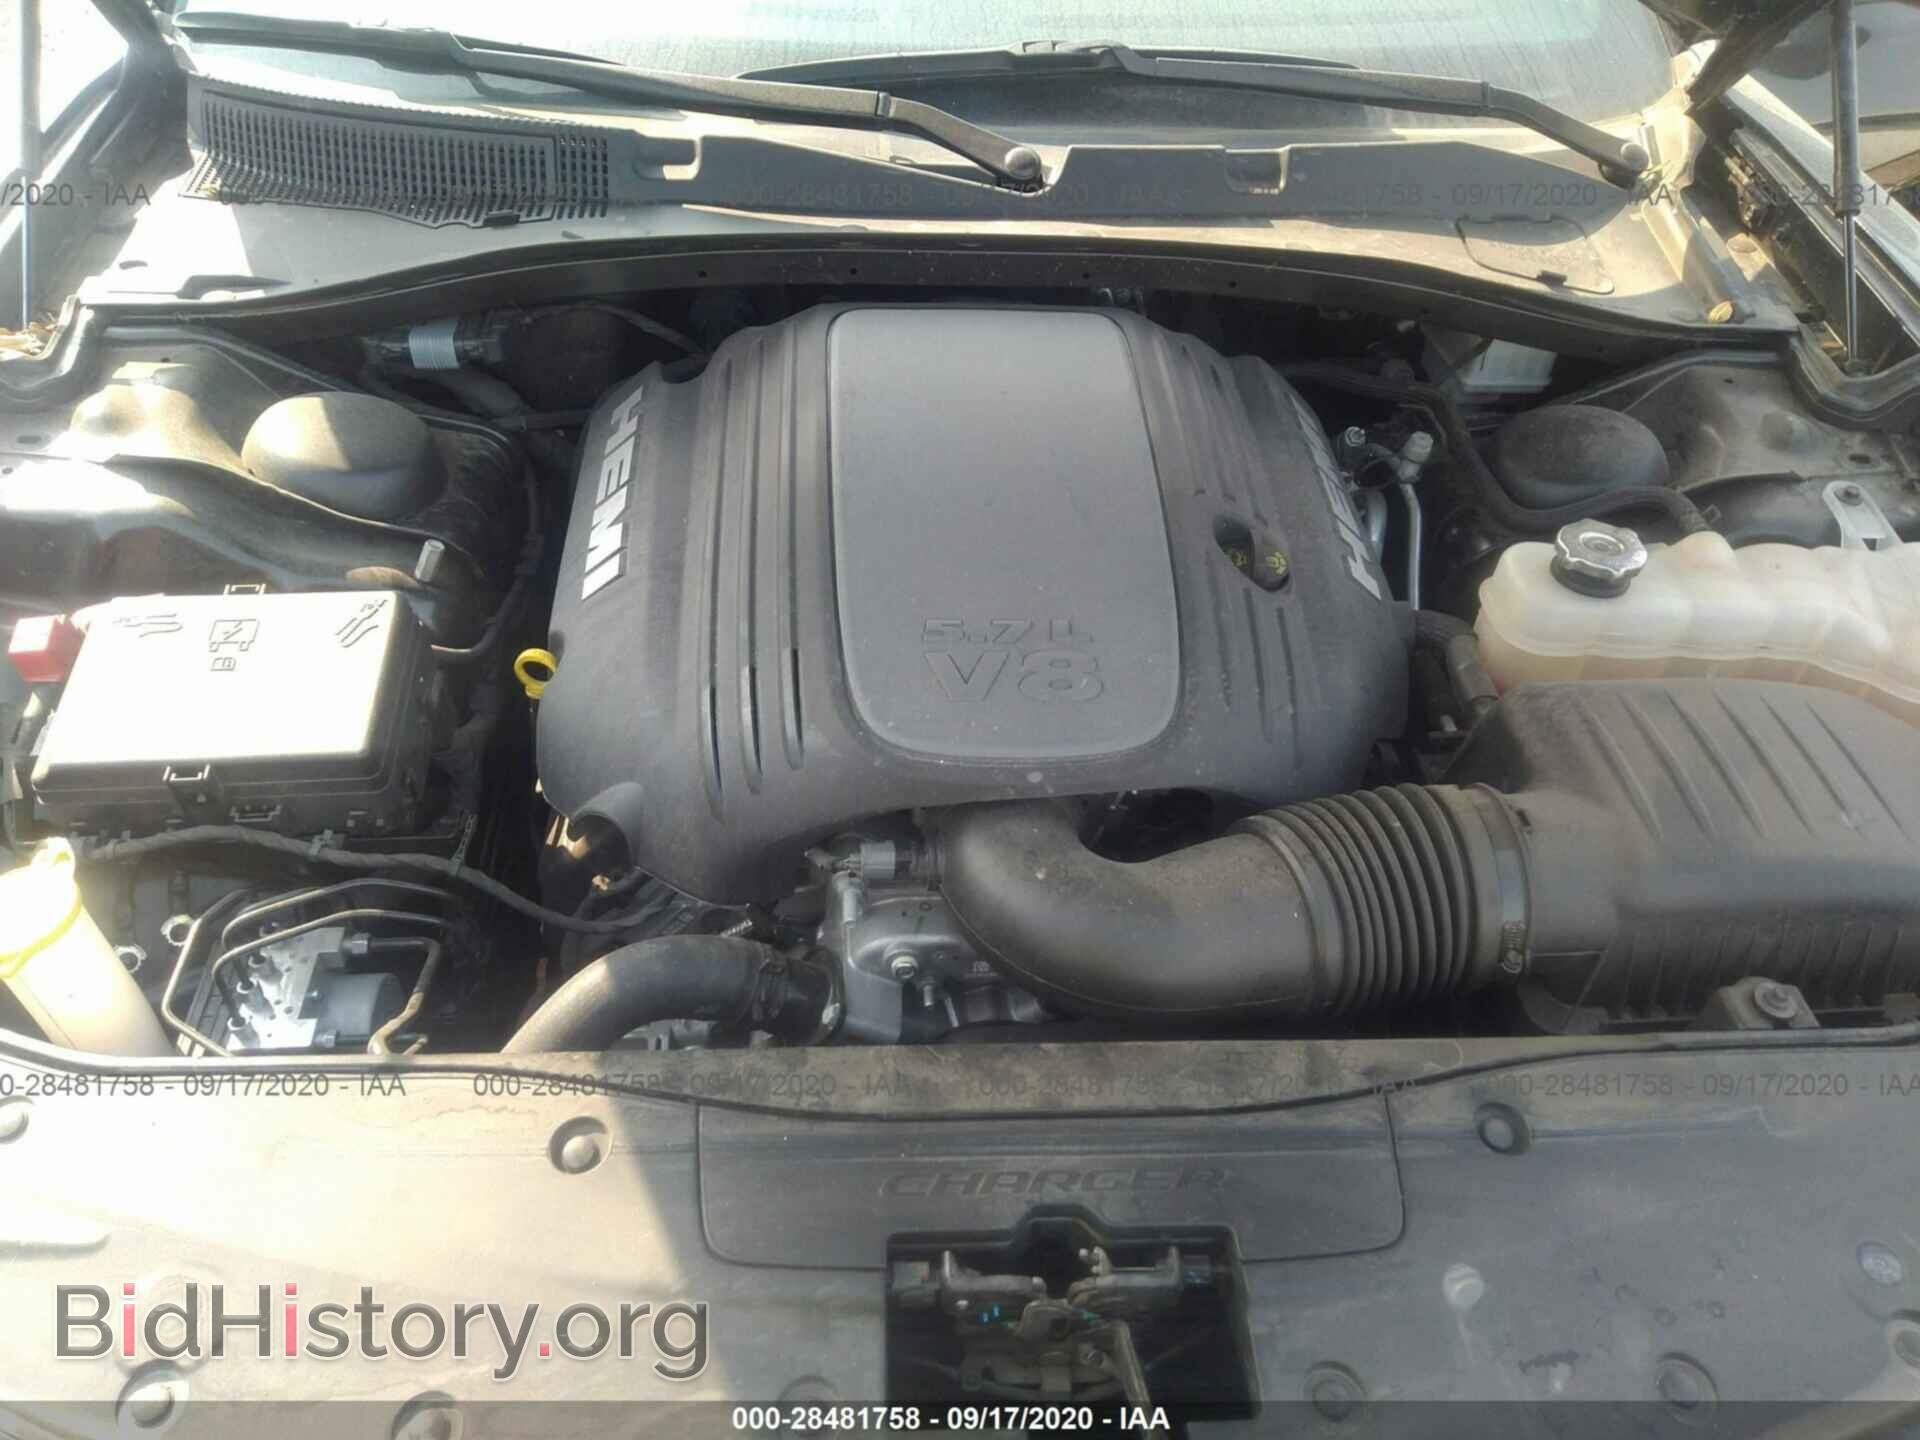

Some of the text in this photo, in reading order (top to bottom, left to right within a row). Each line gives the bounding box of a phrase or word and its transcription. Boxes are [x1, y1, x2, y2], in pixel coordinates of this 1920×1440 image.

[581, 385, 643, 600] HEMI
[924, 650, 1105, 702] V8
[878, 1166, 1233, 1198] CHARGER
